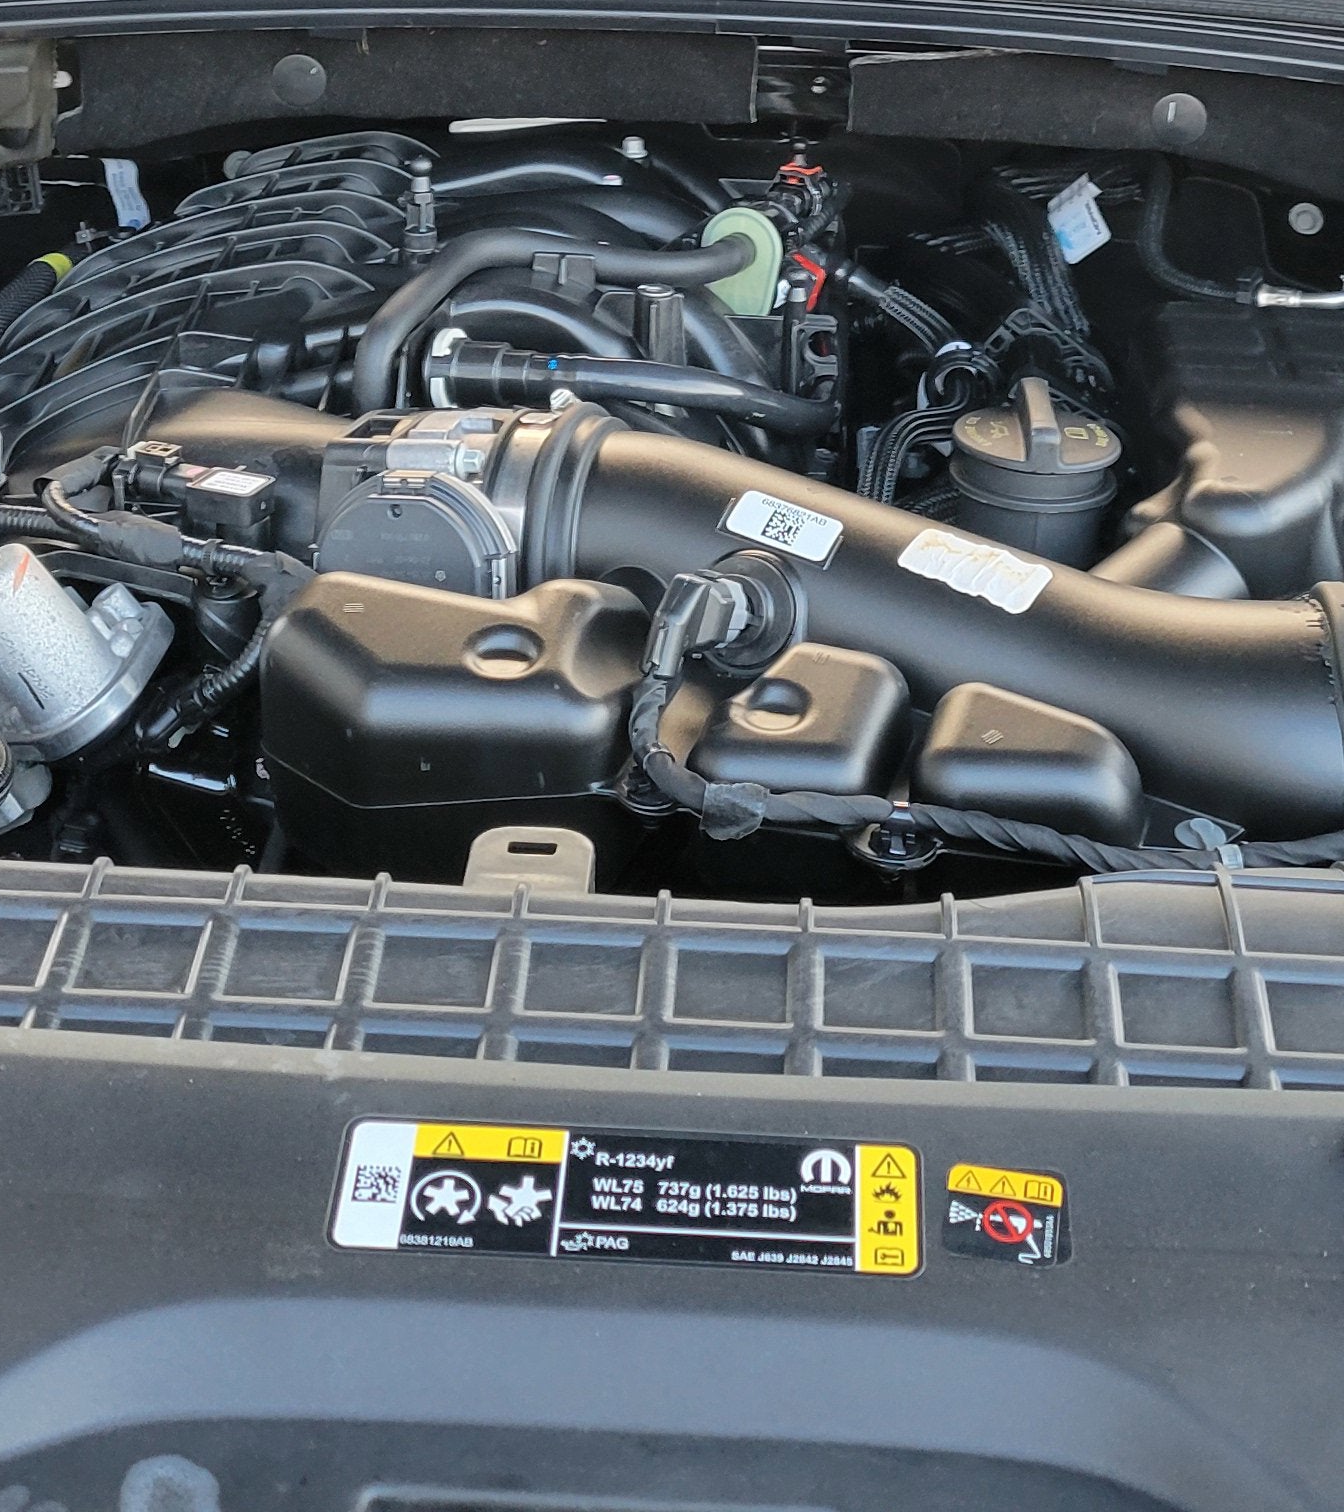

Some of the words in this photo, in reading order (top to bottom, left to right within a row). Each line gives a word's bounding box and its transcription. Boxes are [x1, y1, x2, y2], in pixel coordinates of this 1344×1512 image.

[594, 1150, 676, 1172] R-1234yf
[591, 1176, 645, 1194] WL75
[657, 1180, 702, 1200] 737g
[704, 1182, 759, 1201] (1.625
[762, 1185, 798, 1205] lbs)
[590, 1194, 644, 1212] WL74
[655, 1197, 701, 1218] 624g
[703, 1200, 759, 1219] (1.375
[761, 1202, 797, 1223] lbs)
[595, 1235, 630, 1251] PAG
[730, 1250, 756, 1262] SAE
